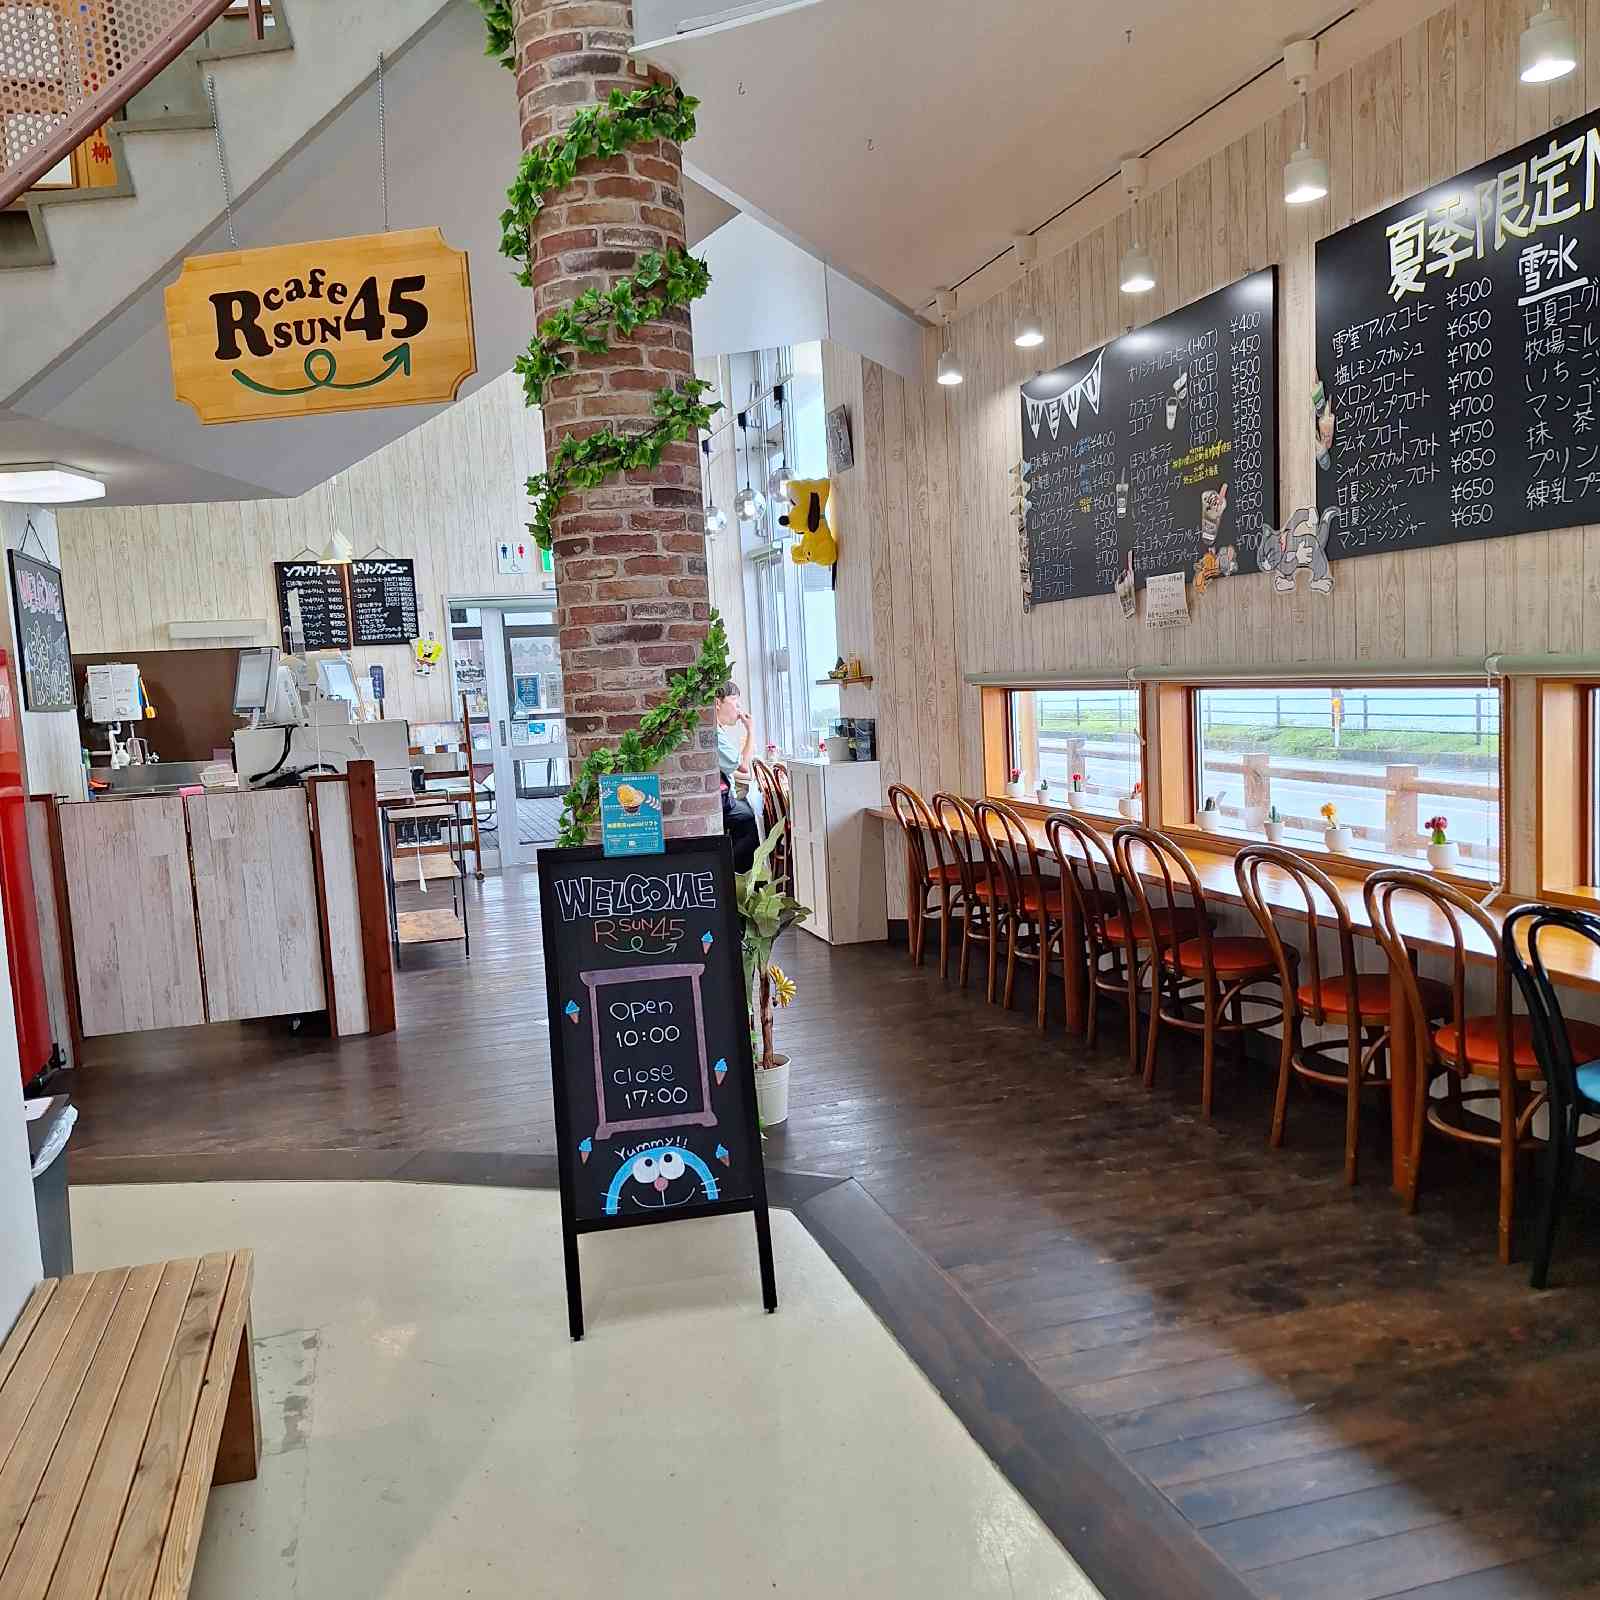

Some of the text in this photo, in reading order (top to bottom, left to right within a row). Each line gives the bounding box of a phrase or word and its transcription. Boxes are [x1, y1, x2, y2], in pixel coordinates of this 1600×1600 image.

[263, 268, 348, 312] cafe
[1446, 276, 1493, 312] ¥500
[1230, 311, 1260, 336] ¥400
[1447, 309, 1492, 344] ¥650
[1230, 334, 1260, 361] ¥450
[1447, 338, 1493, 370] ¥700
[1231, 355, 1260, 381] ¥500
[1232, 375, 1260, 399] ¥500
[1448, 366, 1494, 397] ¥700
[1232, 395, 1261, 418] ¥550
[1449, 396, 1495, 422] ¥700
[1526, 376, 1600, 419] マンゴ
[1232, 414, 1260, 437] ¥500
[1449, 418, 1495, 450] ¥750
[1233, 450, 1262, 472] ¥600
[1450, 447, 1497, 476] ¥850
[1234, 471, 1263, 493] ¥650
[1450, 478, 1495, 506] ¥650
[1234, 490, 1263, 512] ¥650
[1450, 504, 1495, 529] ¥650
[554, 872, 717, 922] WELCOME
[616, 1025, 680, 1048] 10:00
[625, 1087, 688, 1109] 17:00
